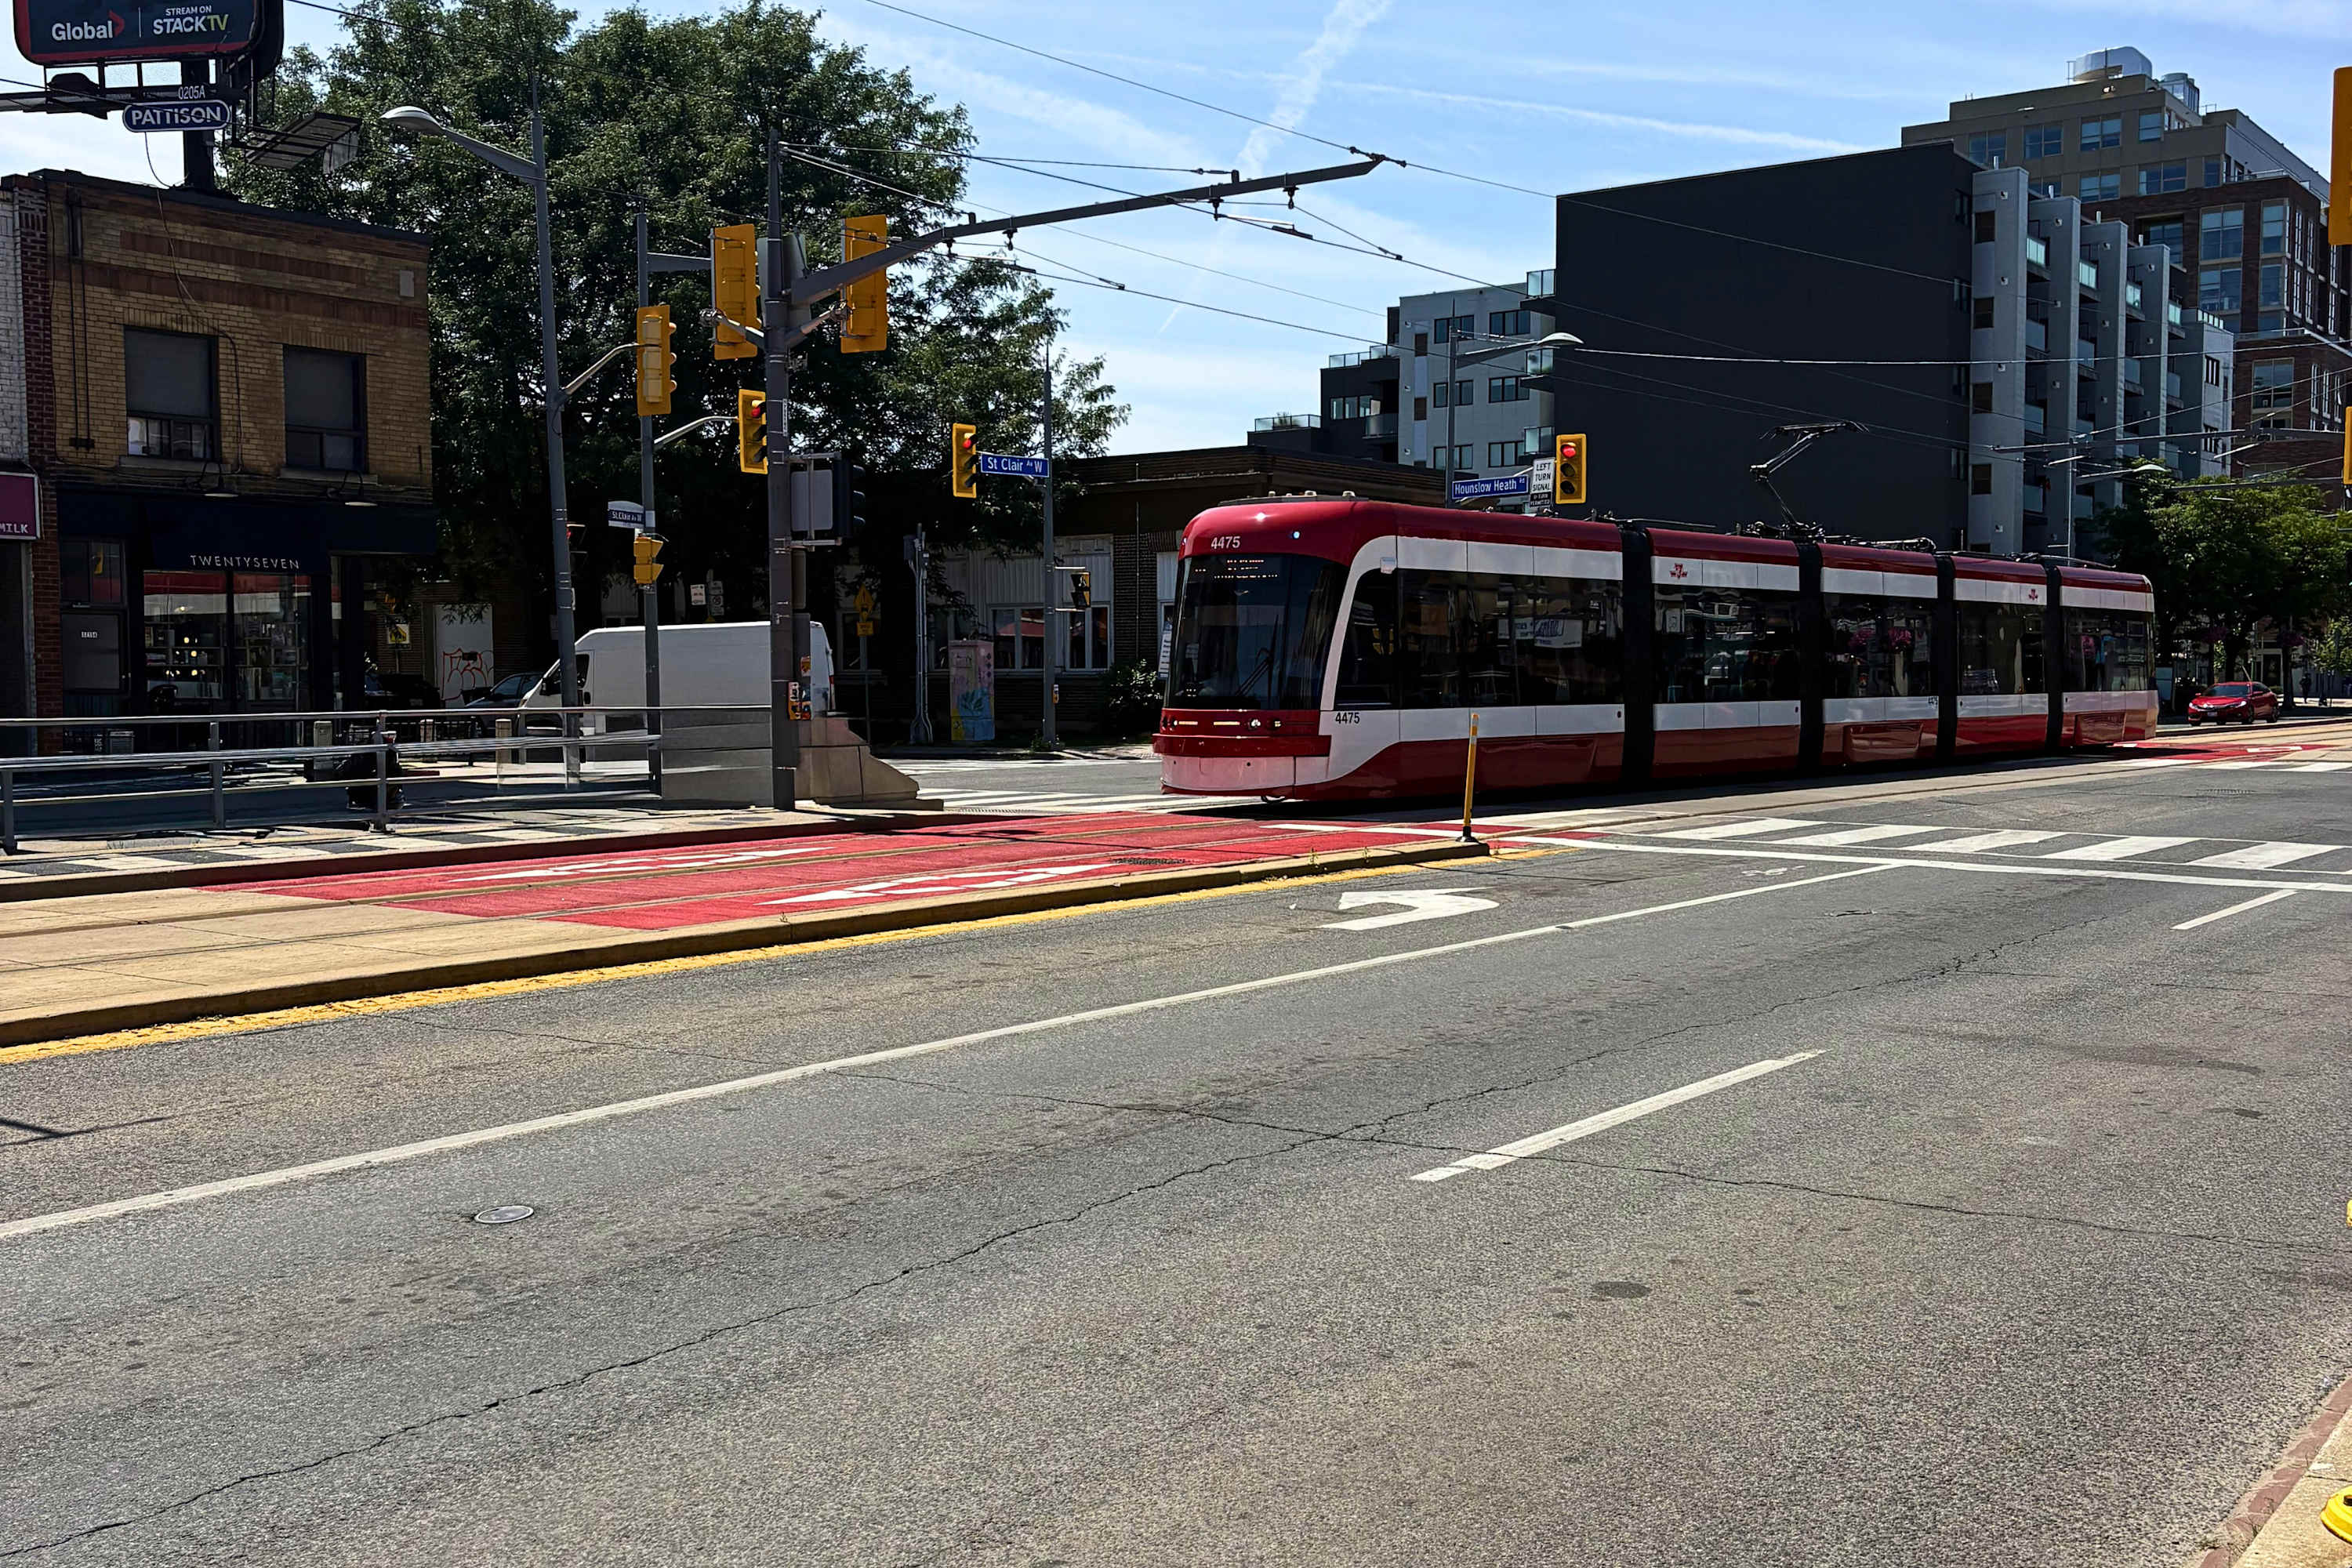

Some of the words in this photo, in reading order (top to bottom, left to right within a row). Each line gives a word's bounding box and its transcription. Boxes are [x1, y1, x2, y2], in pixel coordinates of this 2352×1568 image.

[165, 7, 198, 16] STREAM
[199, 5, 212, 14] ON
[52, 21, 113, 41] Global
[153, 14, 229, 35] STACKTV
[178, 85, 205, 100] 0205A
[132, 107, 221, 126] PATTISON
[988, 456, 998, 470] St
[1001, 459, 1023, 471] Clair
[1034, 460, 1043, 473] W
[1537, 463, 1551, 471] LEFT
[1535, 473, 1552, 481] TURN
[1455, 482, 1492, 495] Hounslow
[1494, 478, 1517, 492] Heath
[1532, 483, 1551, 492] SIGNAL
[1210, 536, 1240, 549] 4475
[190, 555, 299, 569] TWENTYSEVEN
[1335, 712, 1360, 724] 4475
